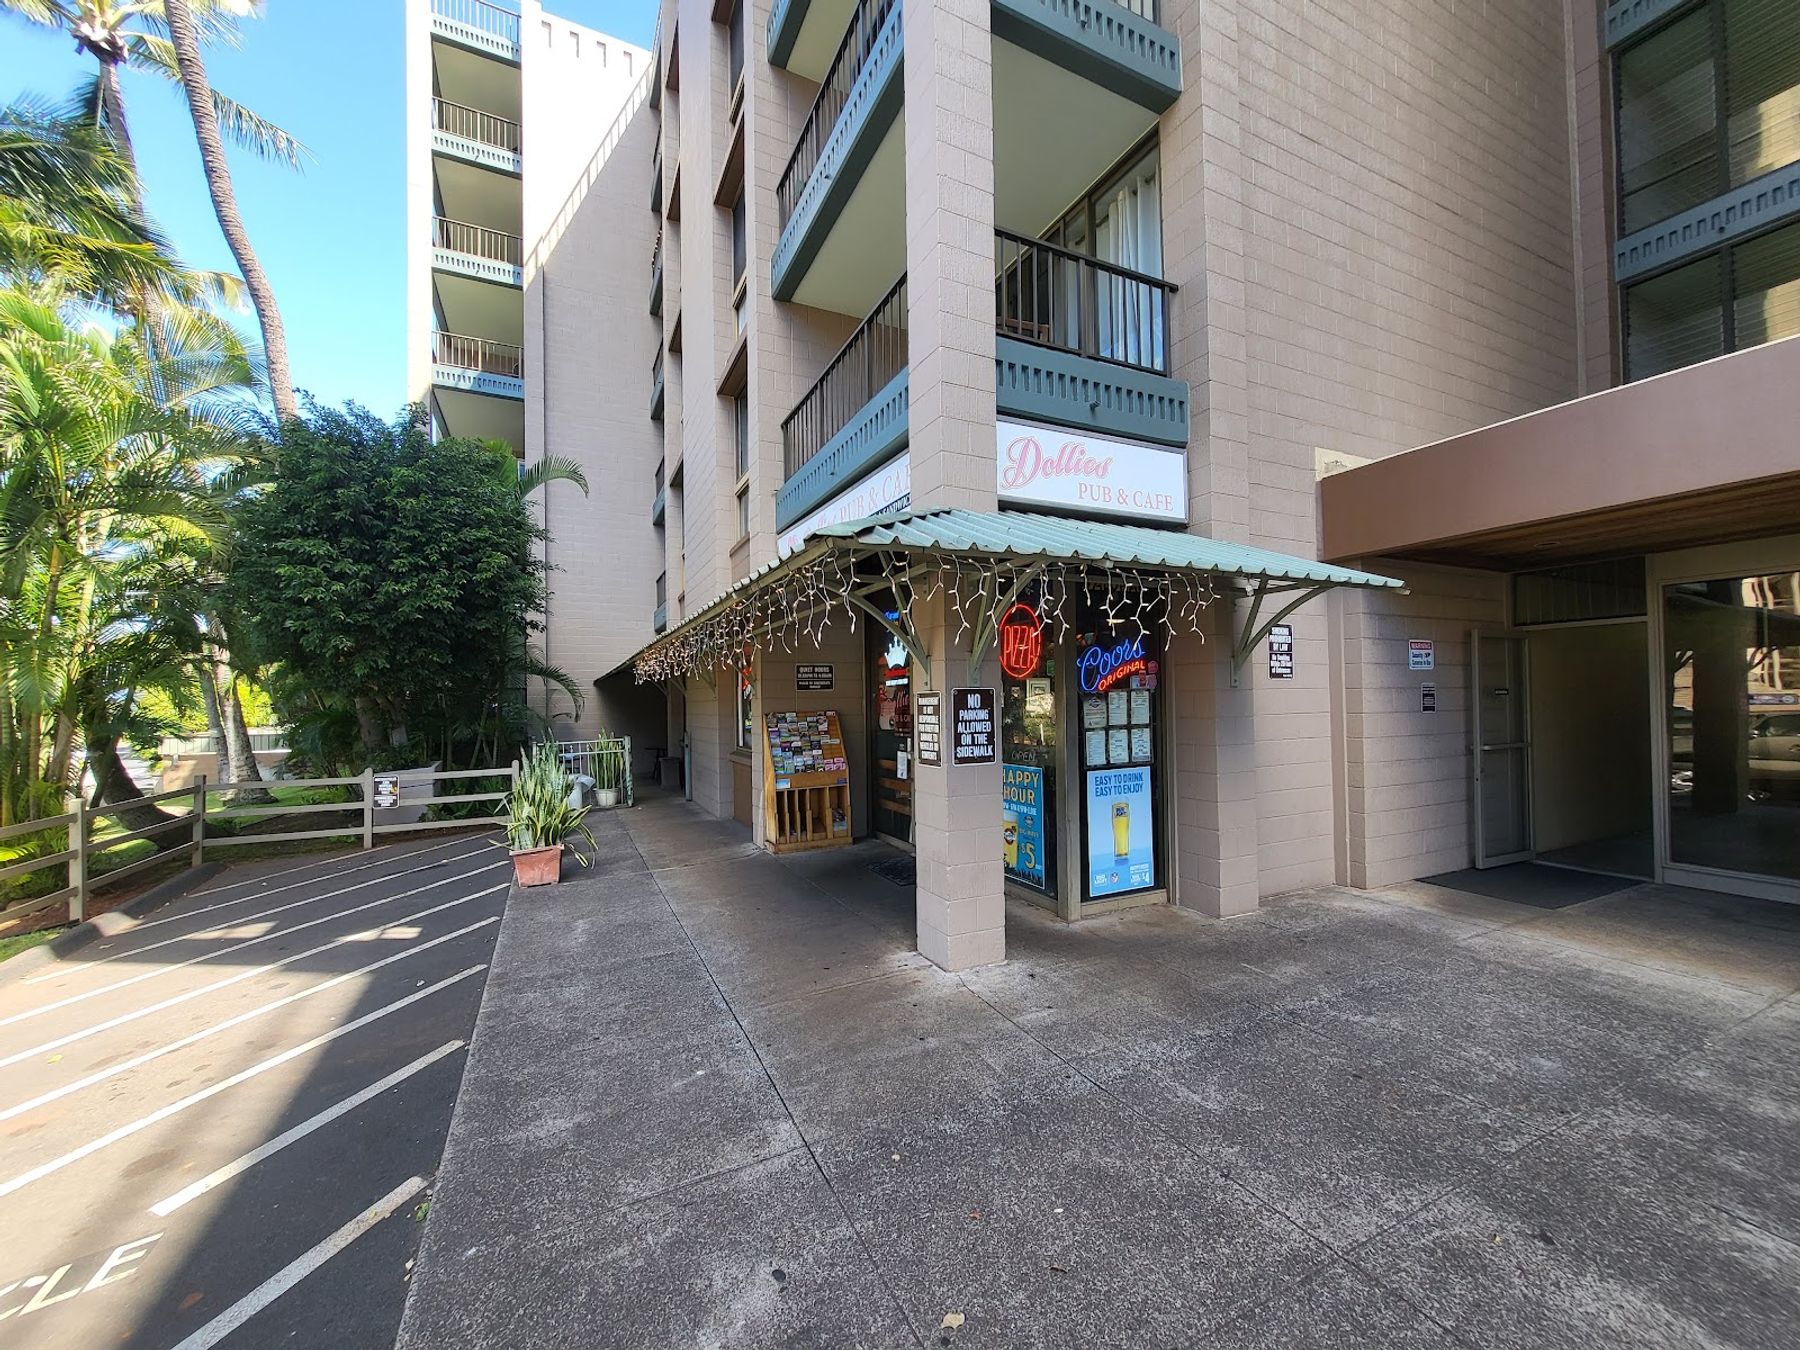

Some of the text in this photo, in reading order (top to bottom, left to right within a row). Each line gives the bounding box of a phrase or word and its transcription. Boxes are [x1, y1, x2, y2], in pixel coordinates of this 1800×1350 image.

[1001, 436, 1113, 490] Dollies
[1078, 482, 1173, 511] PUB & CAFE
[1003, 625, 1040, 669] PIZZA
[1077, 638, 1146, 692] Coors
[1098, 660, 1145, 692] ORIGINAL
[967, 693, 981, 709] NO
[959, 708, 989, 721] PARKING
[957, 721, 992, 734] ALLOWED
[961, 733, 988, 745] ON THE
[956, 745, 993, 758] SIDEWALK
[1094, 772, 1143, 786] EASY TO DRINK
[1004, 785, 1035, 805] HOUR
[1095, 783, 1143, 797] EASY TO ENJOY
